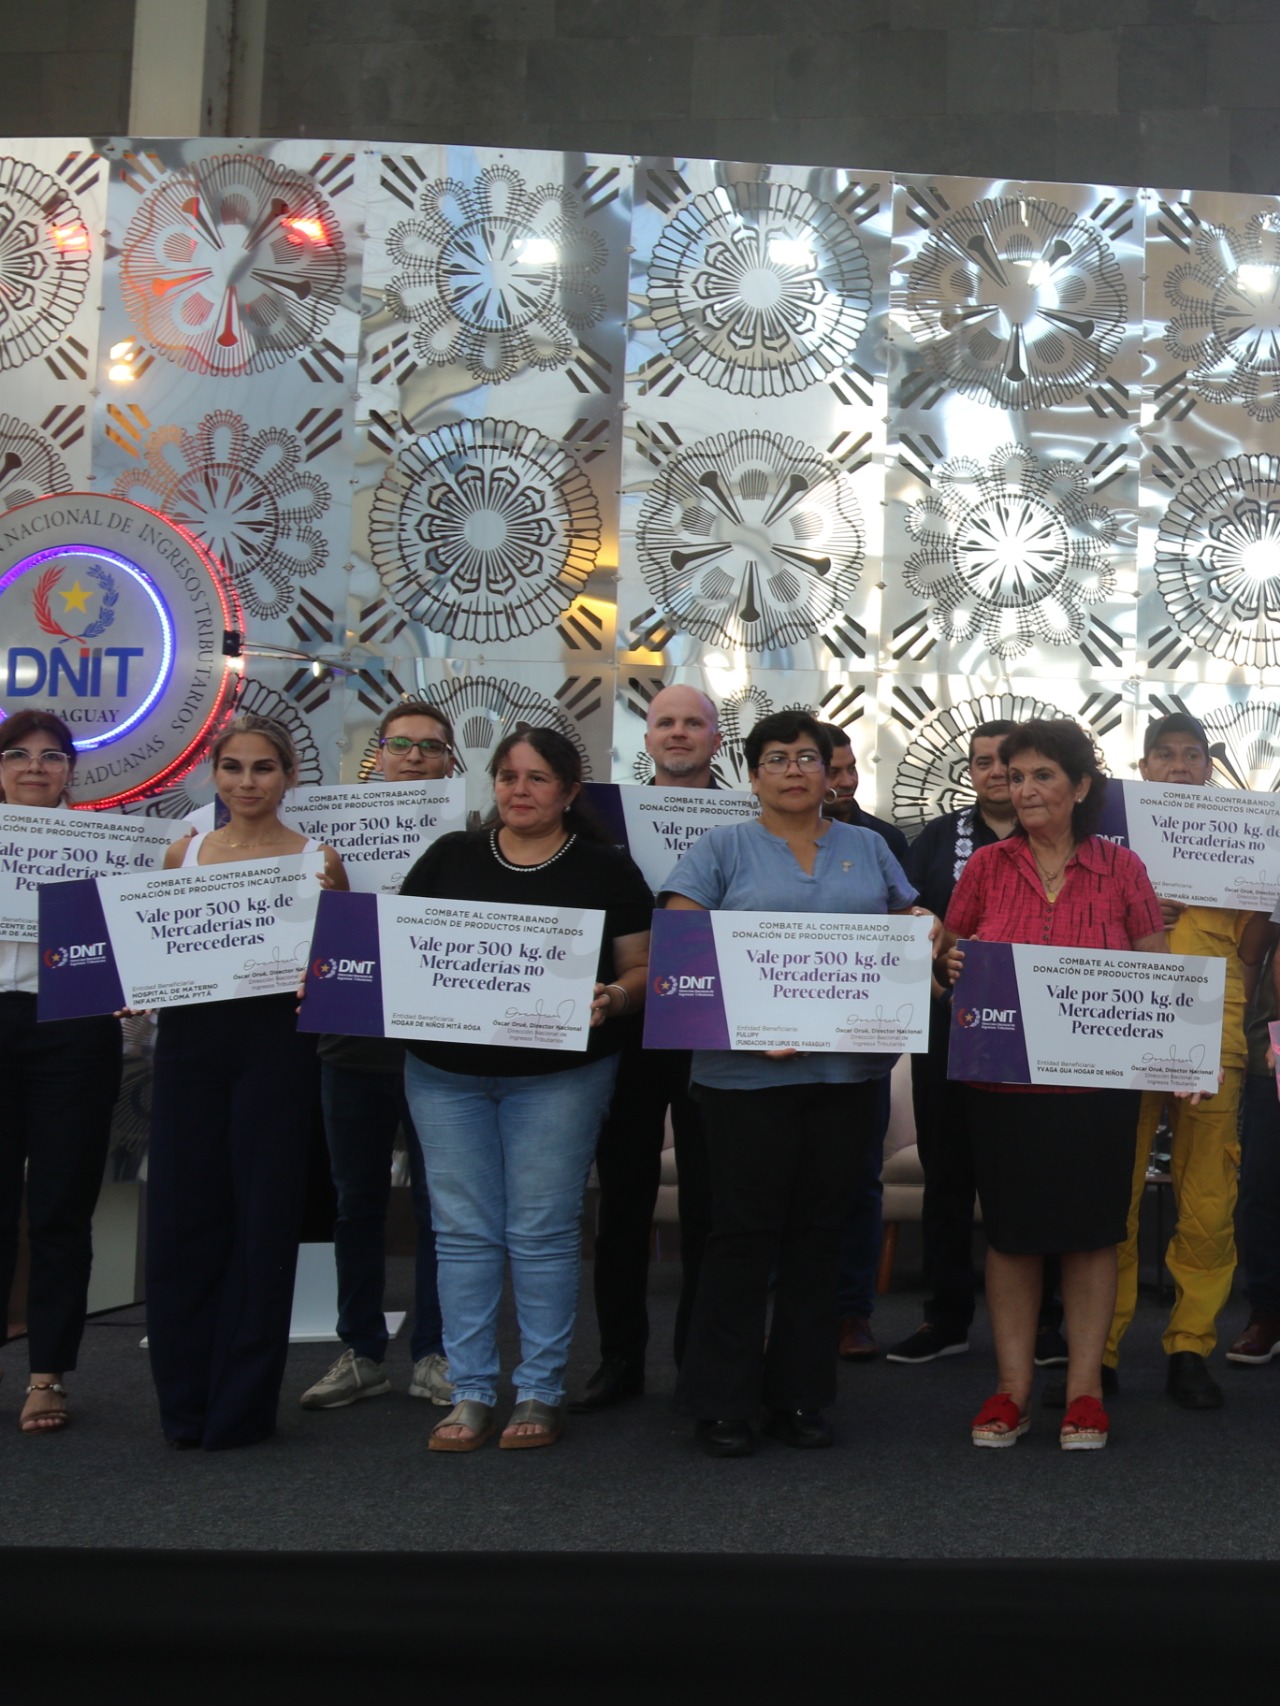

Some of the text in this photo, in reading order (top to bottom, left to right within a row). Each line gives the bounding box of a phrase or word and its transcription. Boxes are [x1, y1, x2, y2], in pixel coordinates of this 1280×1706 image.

[3, 508, 214, 734] NACIONAL DE INGRESOS TRIBUTARIOS
[6, 647, 144, 698] DNIT
[84, 734, 165, 786] ADUANAS
[297, 814, 437, 836] Vale por 500 kg. de
[1151, 815, 1180, 829] Vale
[1182, 821, 1206, 833] por
[1209, 820, 1238, 834] 500
[1244, 822, 1263, 839] kg.
[1161, 830, 1265, 851] Mercaderías no
[27, 848, 58, 862] por
[63, 847, 98, 863] 500
[105, 850, 130, 869] kg.
[133, 853, 154, 868] de
[1172, 846, 1255, 865] Perecederas
[136, 893, 293, 924] Vale por 500 kg. de
[425, 908, 470, 918] COMBATE
[486, 912, 559, 925] CONTRABANDO
[151, 916, 275, 939] Mercaderías no
[70, 942, 105, 958] DNIT
[166, 933, 265, 955] Perecederas
[410, 935, 566, 962] Vale por 500 kg. de
[338, 959, 375, 975] DNIT
[420, 954, 545, 976] Mercaderías no
[746, 949, 900, 970] Vale por 500 kg. de
[1059, 957, 1185, 973] COMBATE AL CONTRABANDO
[432, 972, 531, 993] Perecederas
[679, 975, 715, 990] DNIT
[759, 966, 881, 983] Mercaderías no
[1033, 965, 1209, 984] DONACIÓN DE PRODUCTOS INCAUTADOS
[132, 990, 169, 999] HOSPITAL
[182, 983, 218, 992] MATERNO
[133, 996, 167, 1005] INFANTIL
[169, 993, 190, 1001] LOMA
[773, 984, 869, 1000] Perecederas
[1046, 984, 1194, 1009] Vale por 500 kg. de
[982, 1008, 1016, 1023] DNIT
[1059, 1002, 1175, 1023] Mercaderías no
[415, 1020, 424, 1028] DE
[425, 1020, 445, 1029] NIÑOS
[1072, 1020, 1164, 1039] Perecederas
[1105, 1069, 1124, 1077] NIÑOS
